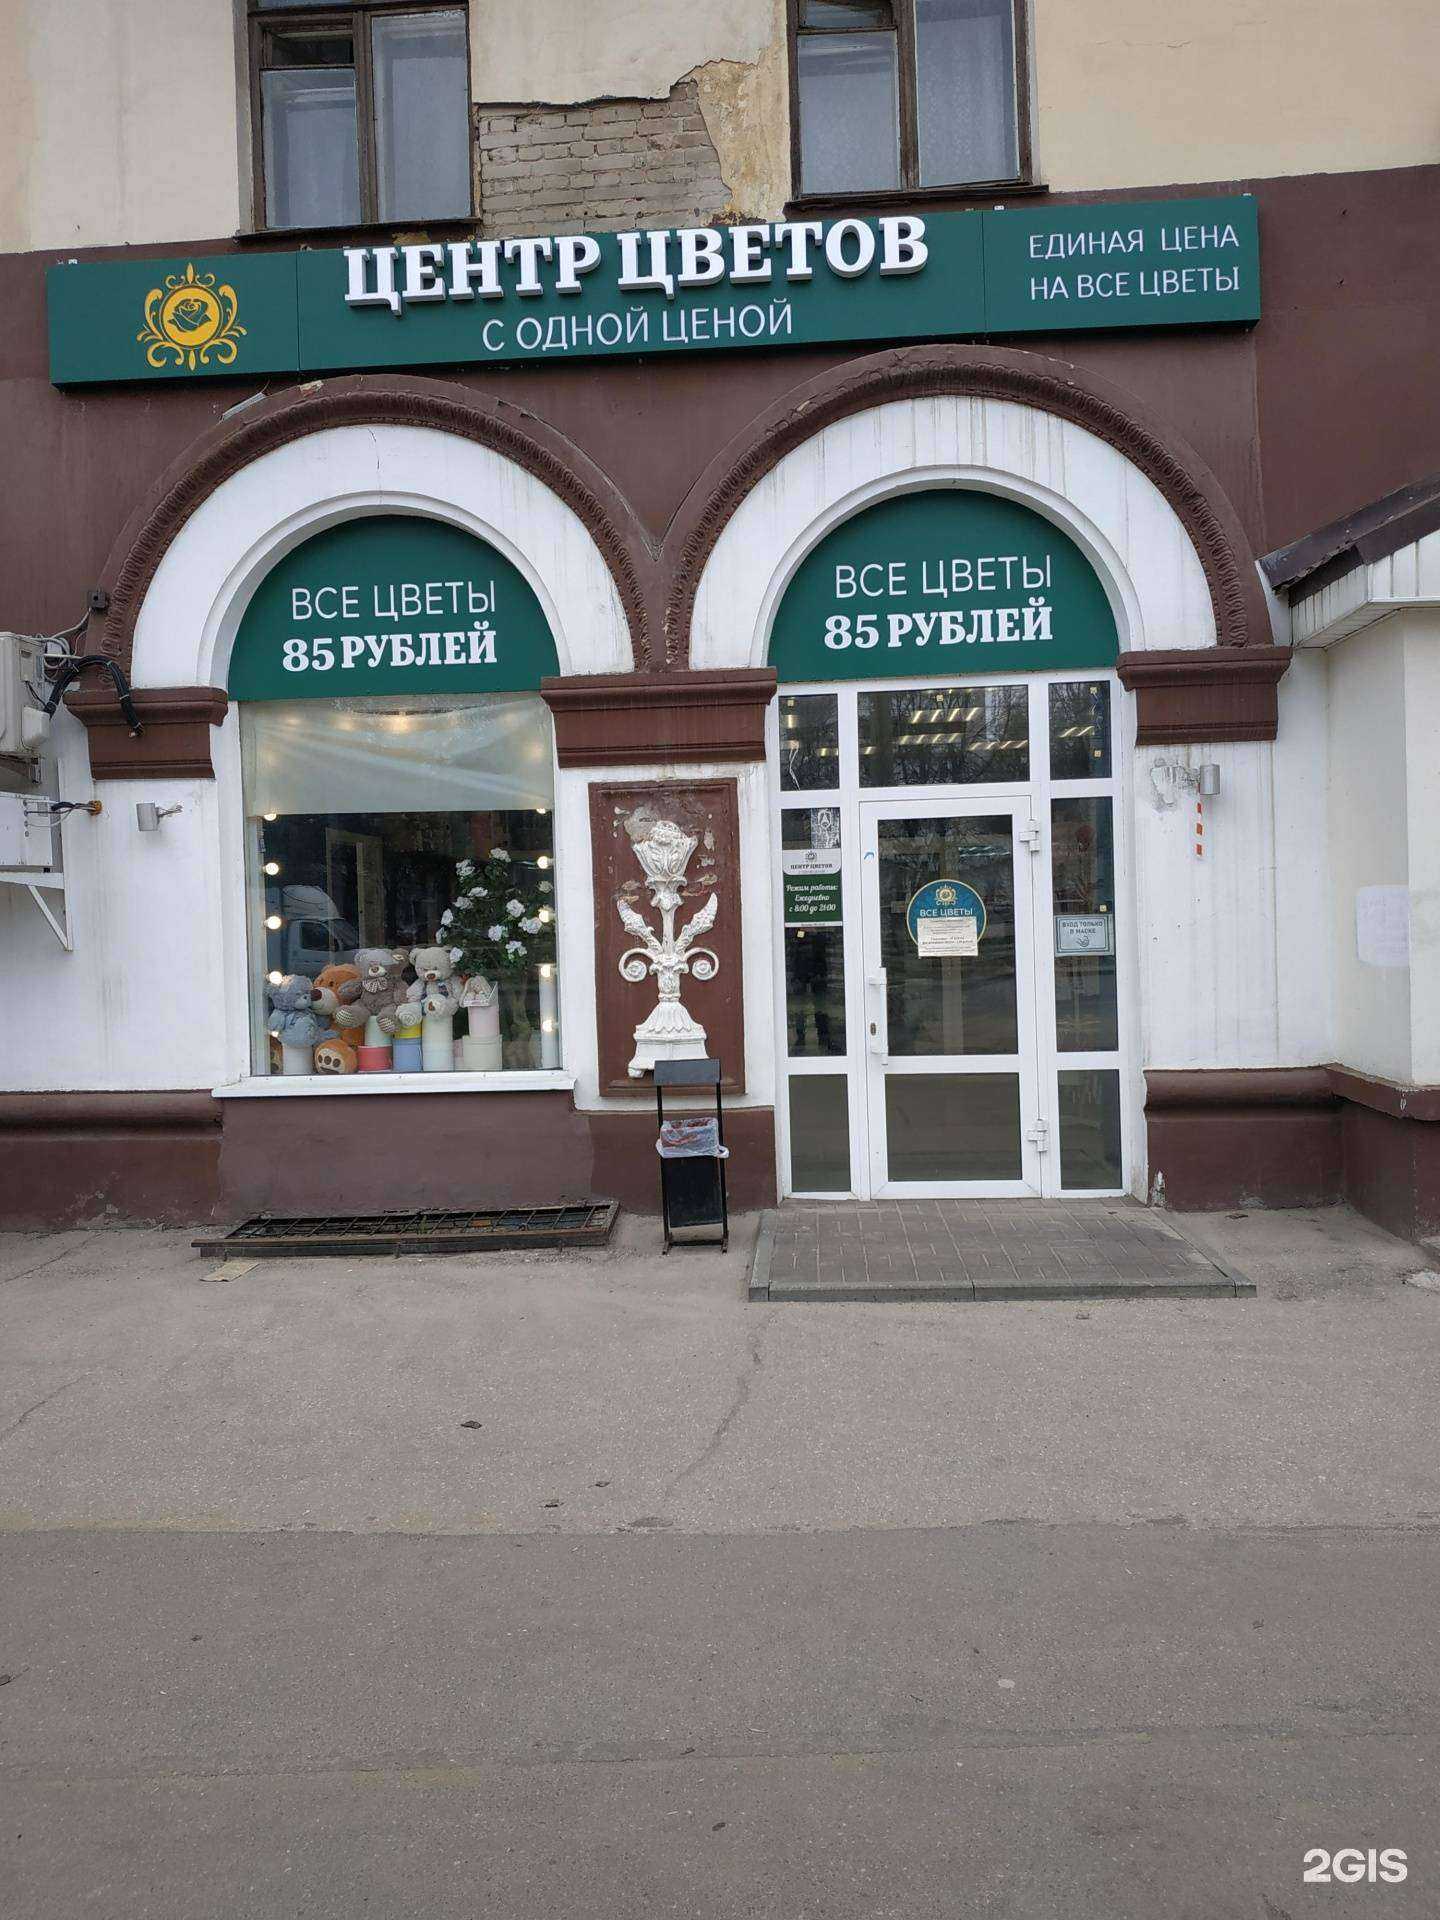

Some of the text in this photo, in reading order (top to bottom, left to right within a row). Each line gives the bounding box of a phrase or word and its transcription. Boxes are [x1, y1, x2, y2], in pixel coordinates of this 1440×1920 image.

[1029, 224, 1240, 260] ЕДИНАЯ ЦЕНА
[343, 216, 929, 316] ЦЕНТР ЦВЕТОВ
[1030, 266, 1240, 300] НА ВСЕ ЦВЕТЫ
[482, 297, 792, 352] С ОДНОЙ ЦЕНОЙ
[835, 554, 1051, 599] ВСЕ ЦВЕТЫ
[292, 580, 496, 621] ВСЕ ЦВЕТЫ
[824, 597, 1054, 650] 85 РУБЛЕЙ
[282, 621, 498, 672] 85 РУБЛЕЙ
[920, 908, 973, 918] ВСЕ ЦВЕТЫ
